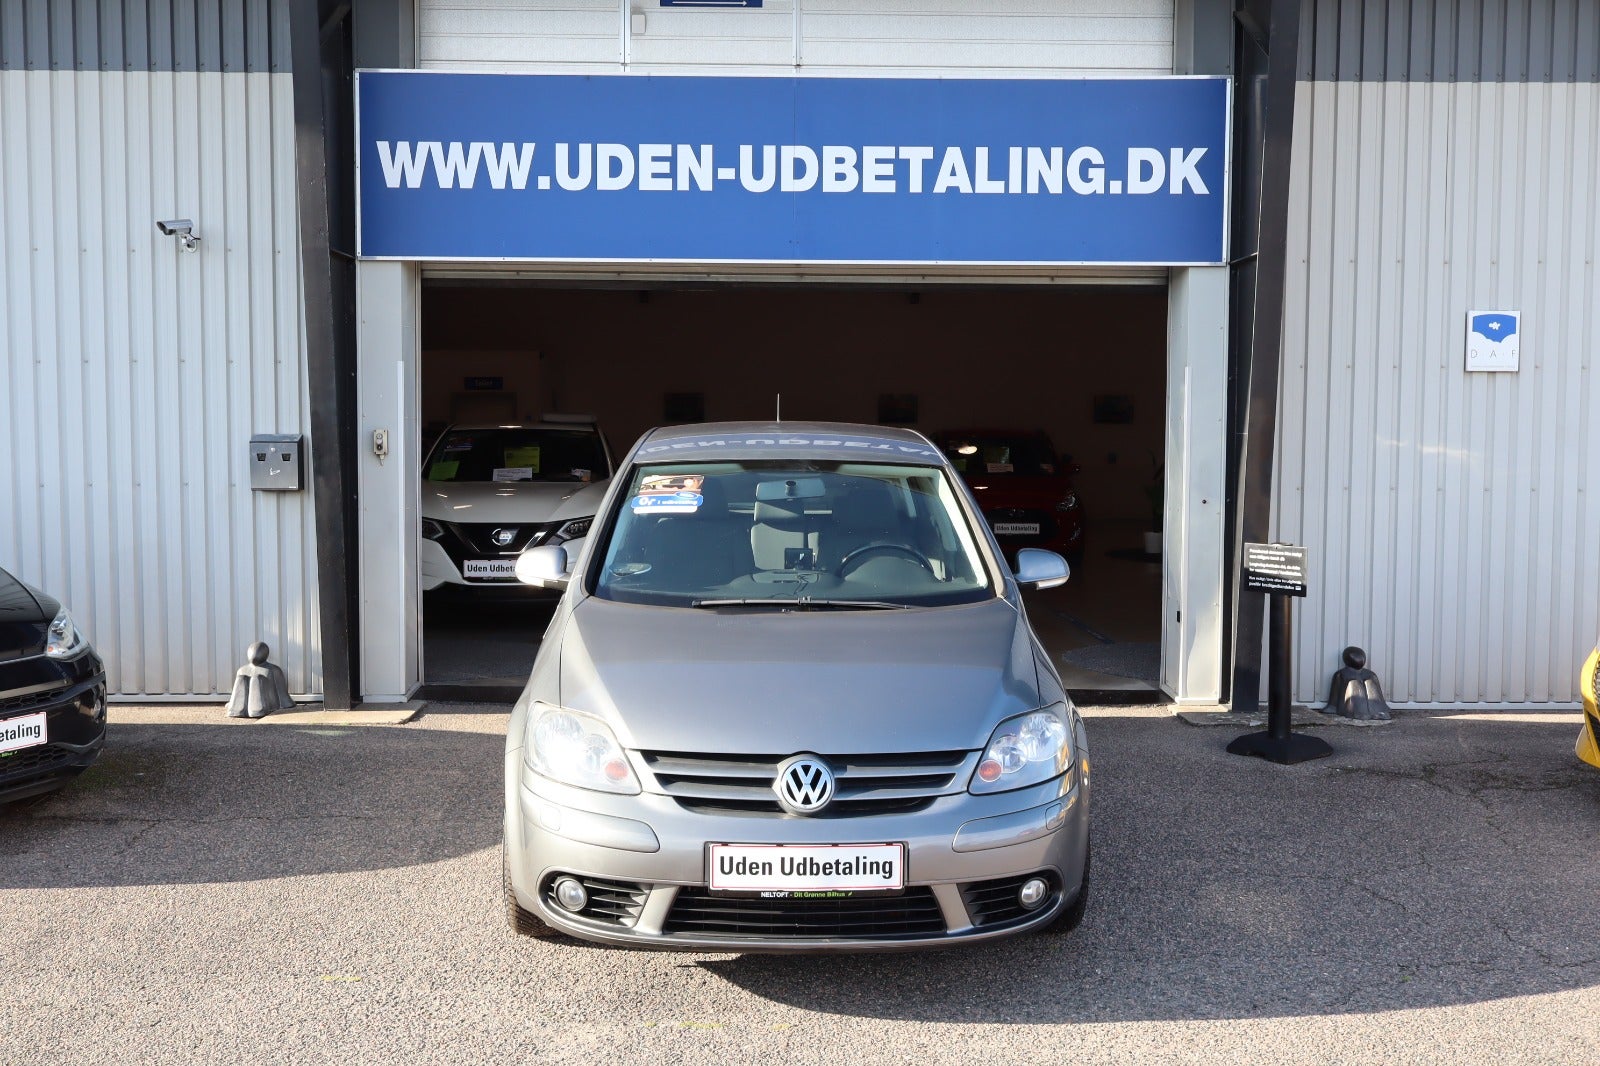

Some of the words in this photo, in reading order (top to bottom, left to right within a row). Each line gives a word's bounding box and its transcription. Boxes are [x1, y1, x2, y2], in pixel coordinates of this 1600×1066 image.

[376, 140, 1210, 195] WWW.UDEN-UDBETALING.DK
[467, 564, 488, 572] Uden
[720, 856, 773, 876] Uden
[780, 856, 894, 879] Udbetaling
